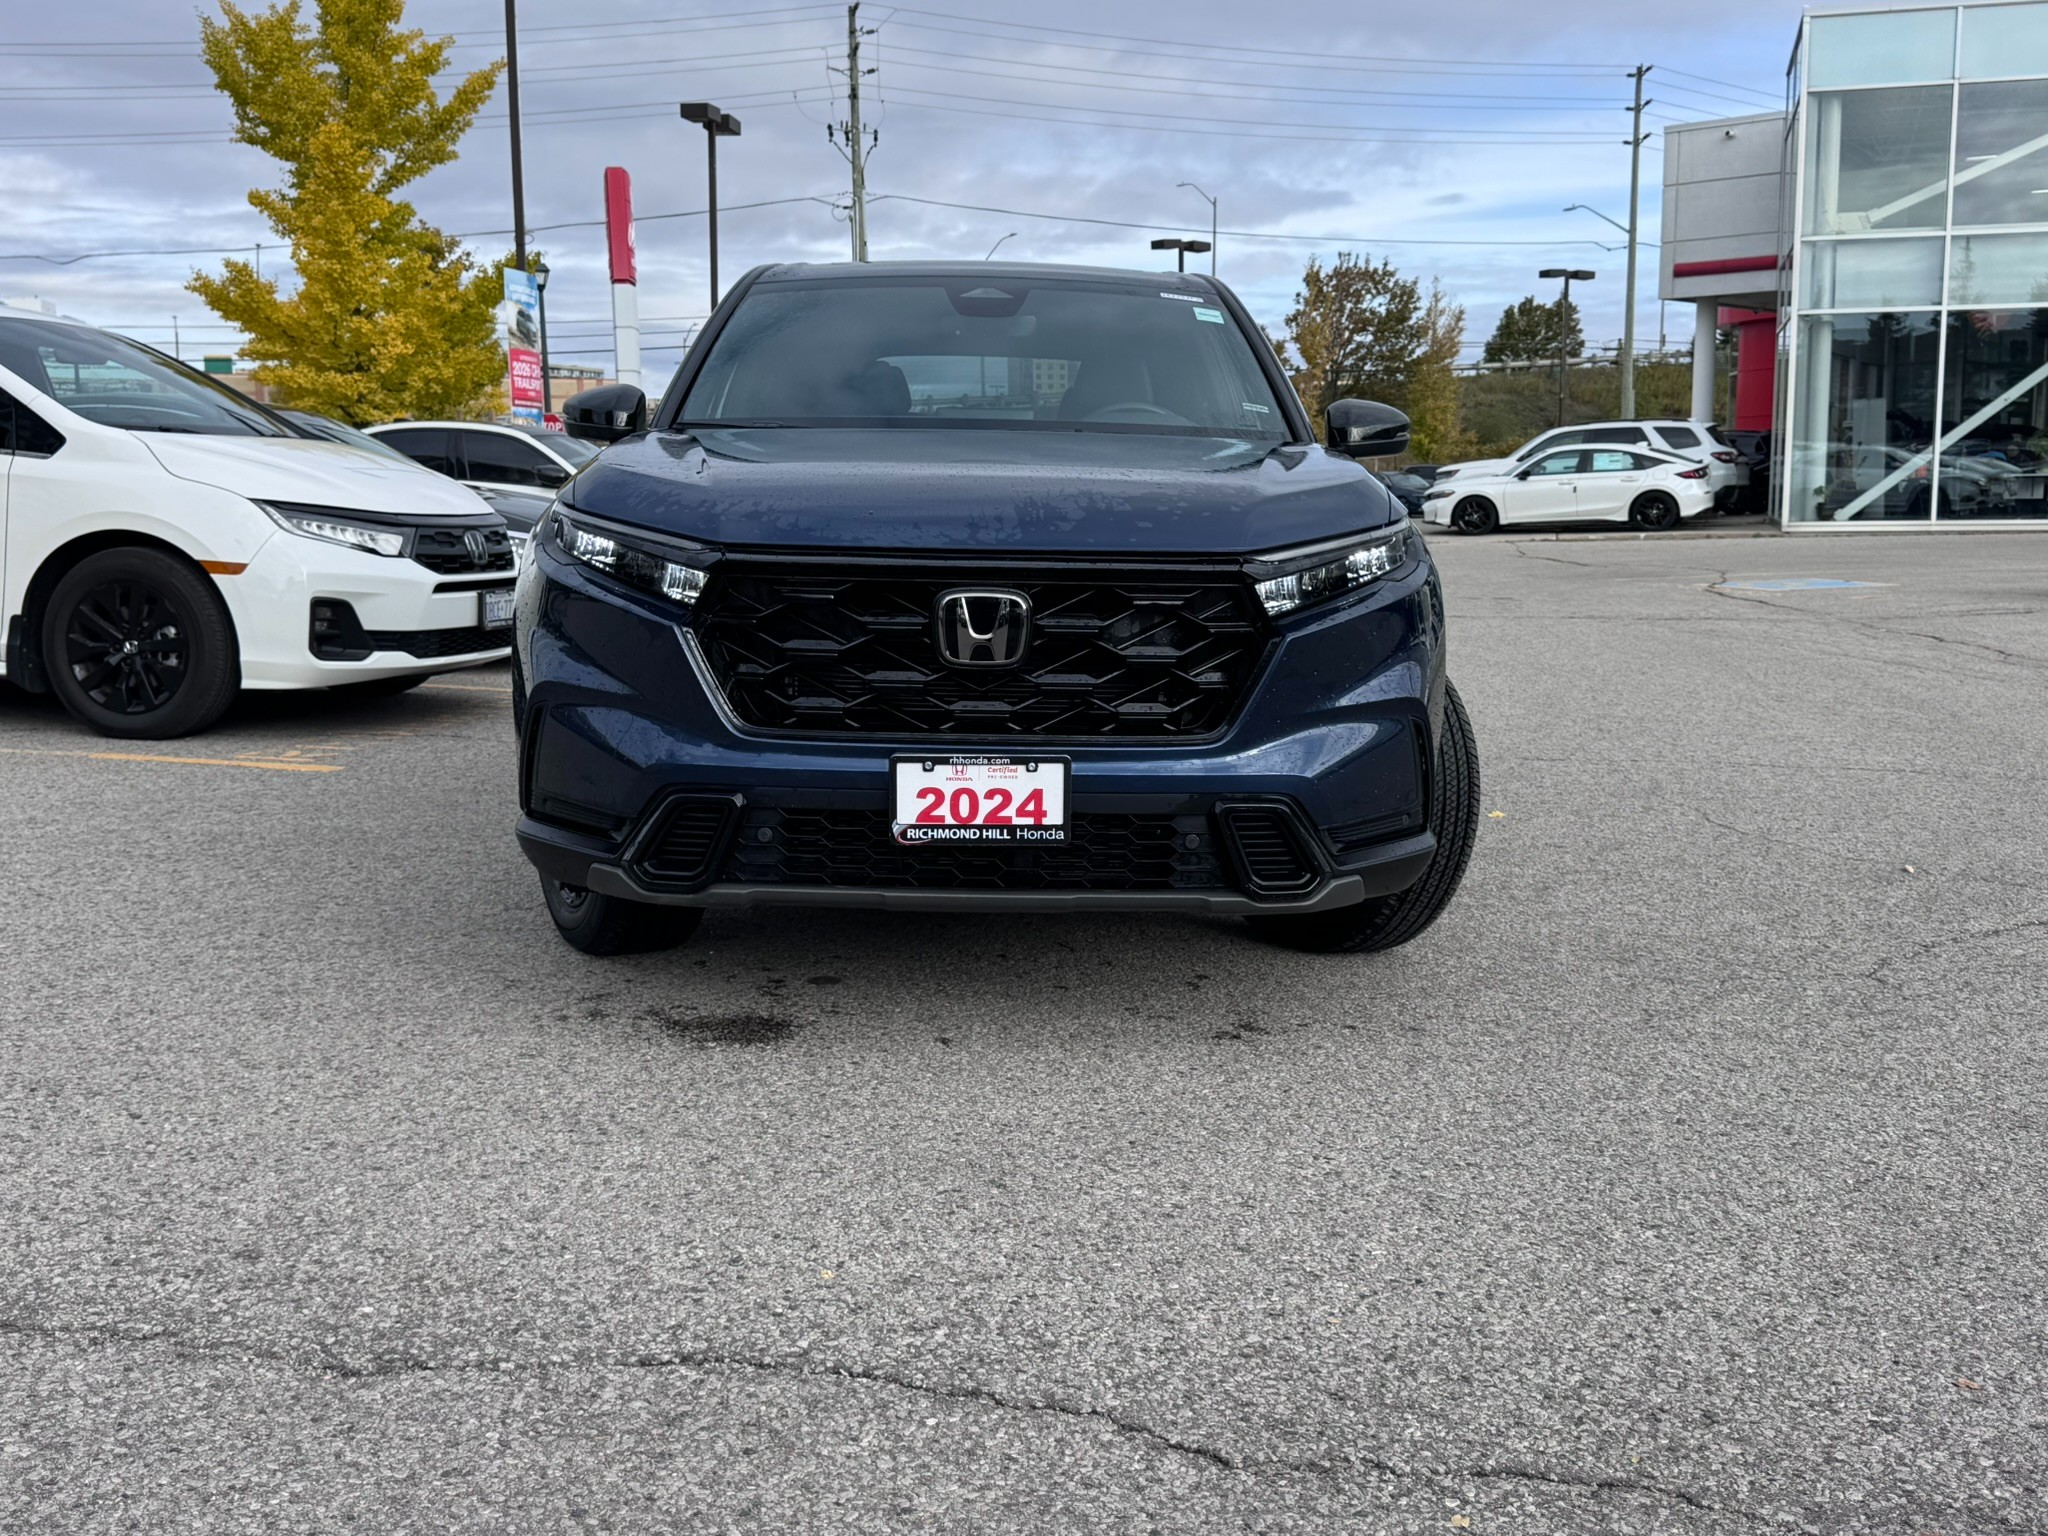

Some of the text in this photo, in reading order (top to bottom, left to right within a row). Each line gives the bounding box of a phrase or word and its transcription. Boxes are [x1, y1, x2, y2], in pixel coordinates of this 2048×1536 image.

[544, 422, 562, 431] TOP
[949, 756, 1011, 765] rhhonda.com
[987, 766, 1018, 774] Certified
[915, 786, 1048, 825] 2024
[906, 828, 1065, 840] RICHMOND HILL Honda
